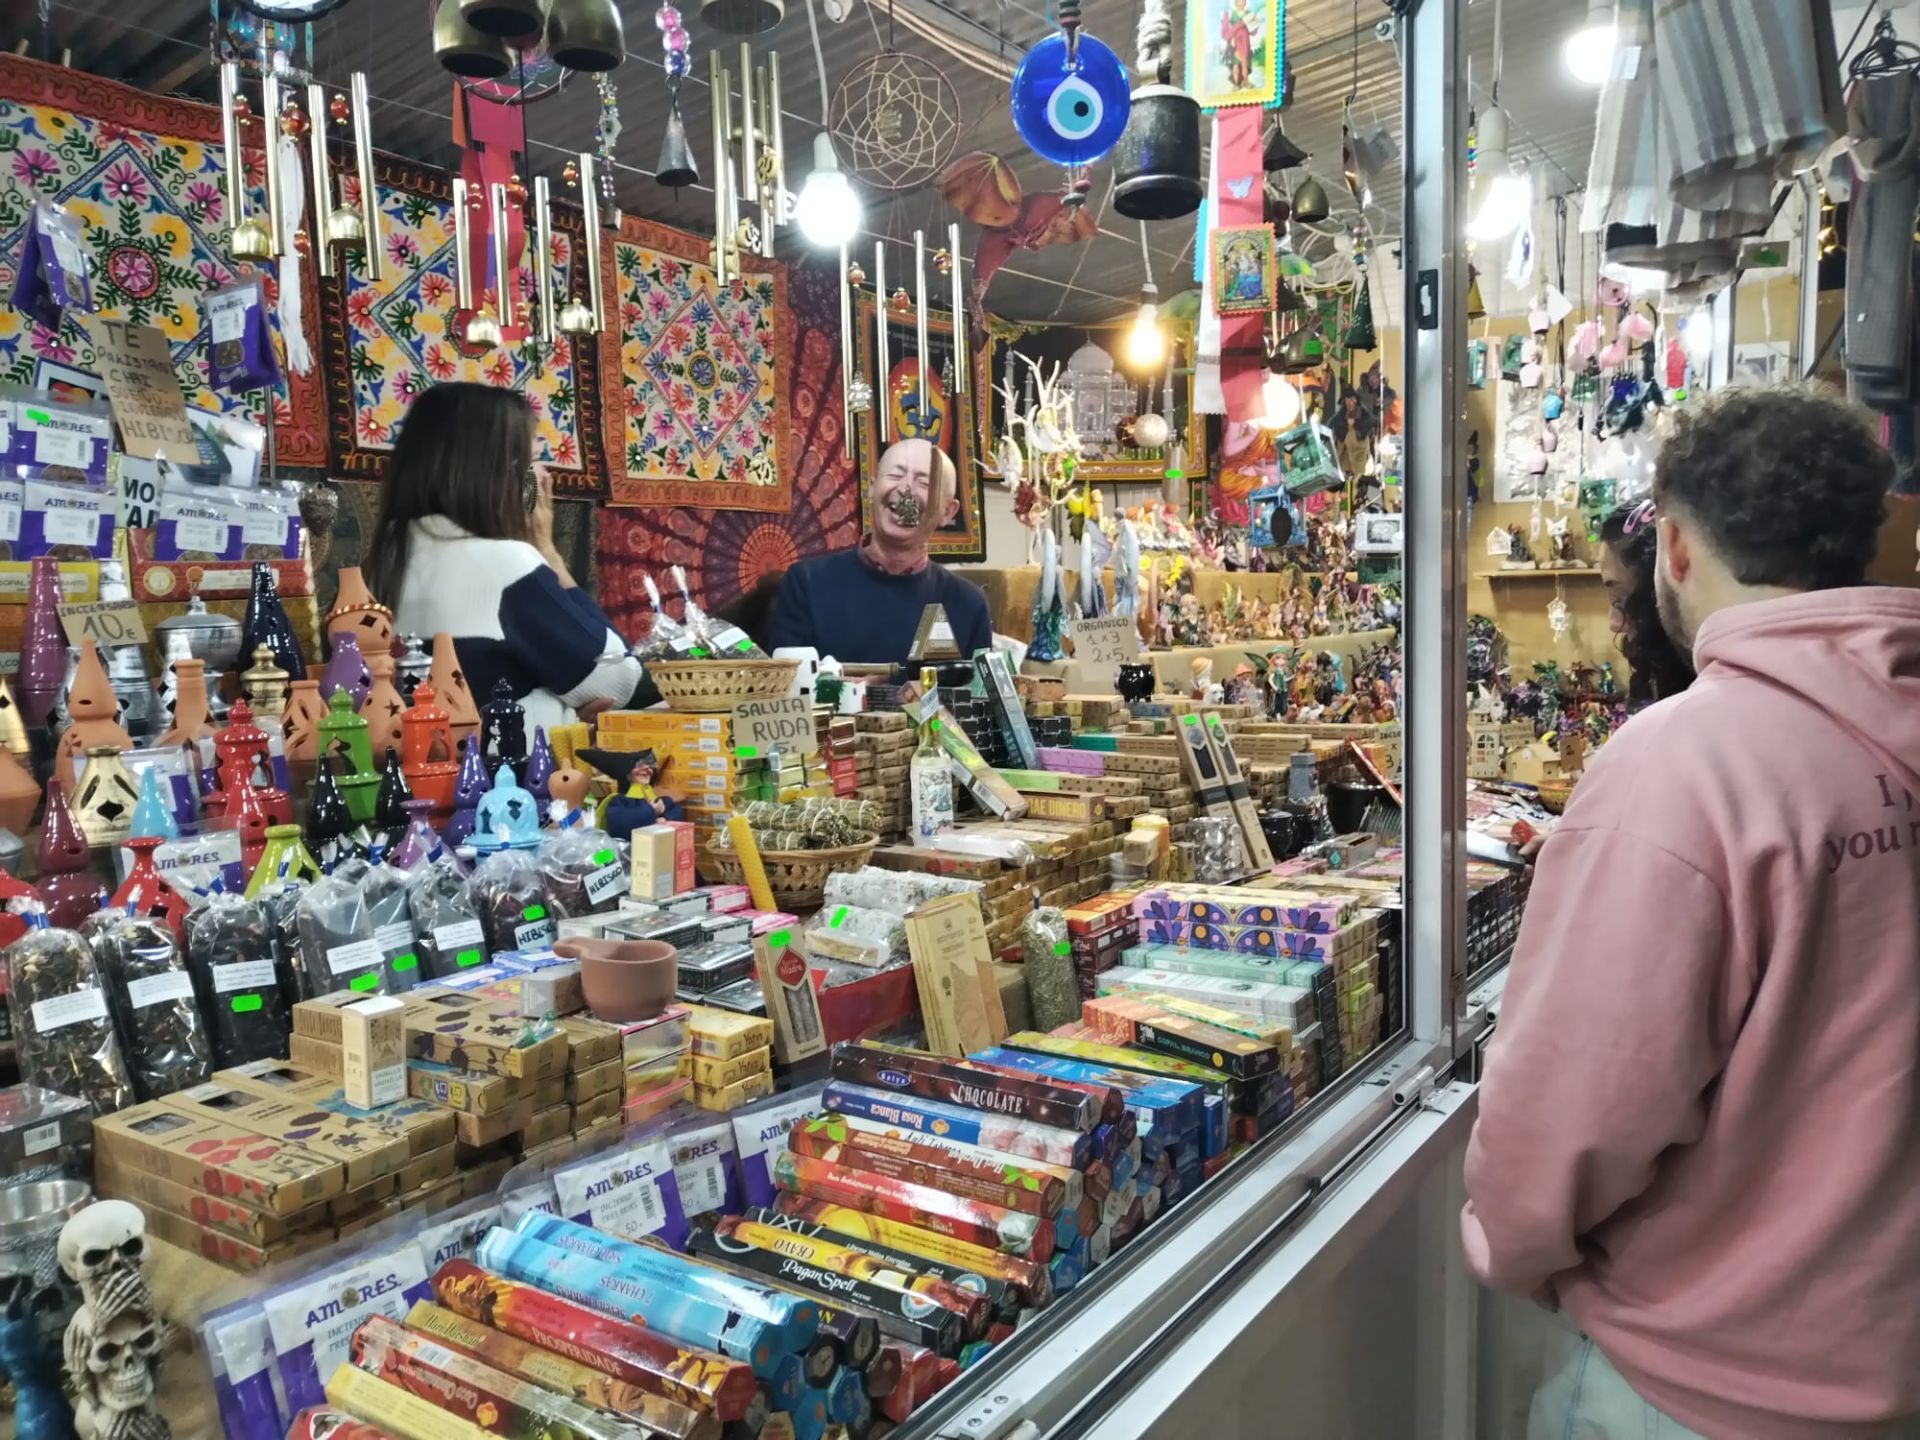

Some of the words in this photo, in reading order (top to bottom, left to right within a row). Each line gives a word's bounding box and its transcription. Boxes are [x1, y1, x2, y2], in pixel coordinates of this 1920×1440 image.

[735, 698, 806, 719] SALVIA
[752, 716, 811, 743] RUDA
[1874, 774, 1897, 808] I
[1824, 825, 1903, 875] you
[957, 1083, 1023, 1114] CHOCOLATE
[870, 1103, 900, 1124] Blanca
[901, 1113, 925, 1130] Rosa
[530, 1325, 625, 1376] PROSPERIDADE
